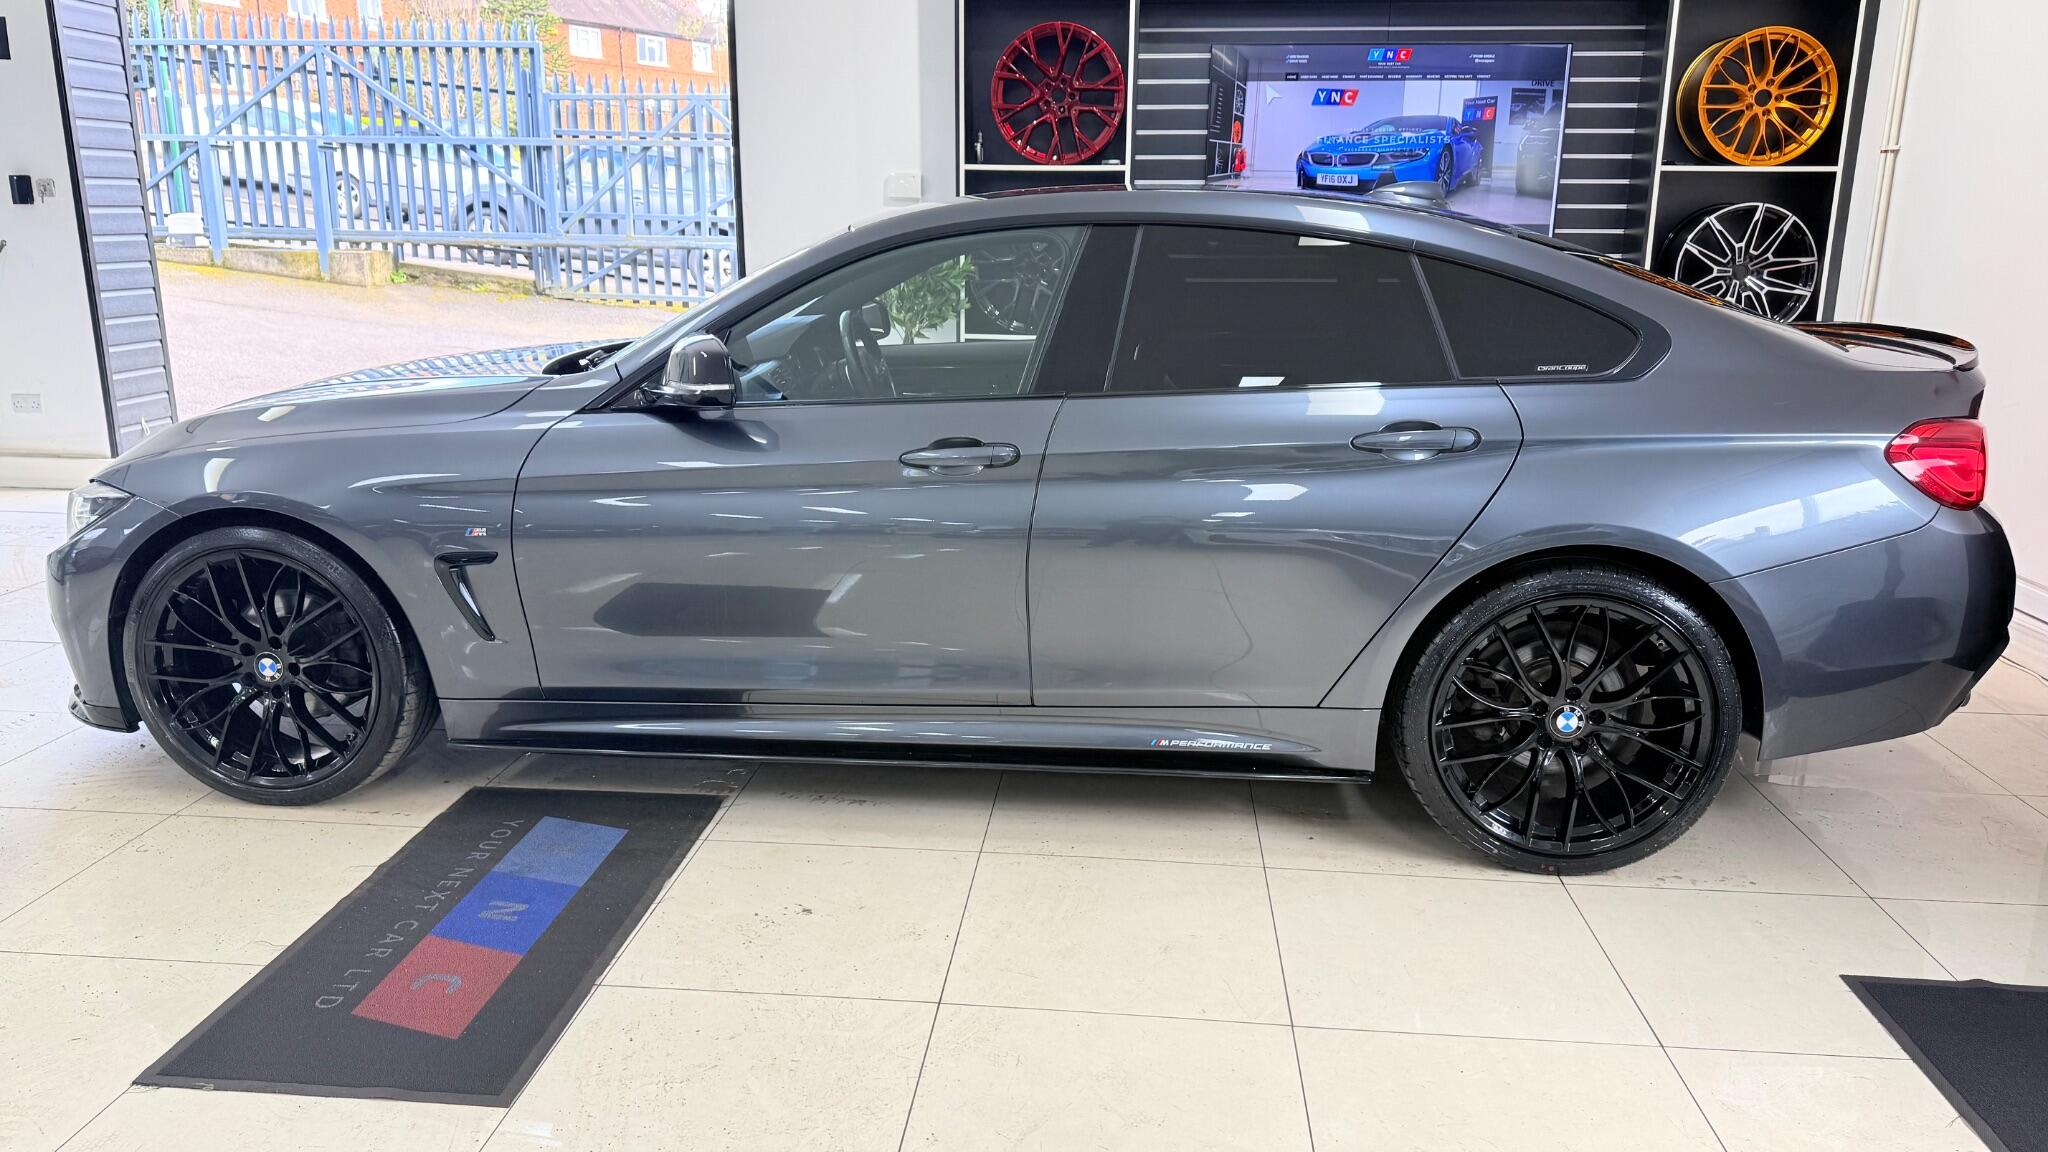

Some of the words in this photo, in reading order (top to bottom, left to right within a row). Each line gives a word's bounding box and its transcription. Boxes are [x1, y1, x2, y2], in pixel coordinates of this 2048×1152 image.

[1373, 50, 1407, 59] YNC
[1531, 79, 1555, 87] DRIVE
[1317, 90, 1354, 103] YNC
[1465, 109, 1493, 119] YNC
[1317, 135, 1369, 144] FINANCE
[1374, 135, 1451, 144] SPECIALISTS
[1170, 738, 1273, 751] PERFORMANCE
[467, 819, 525, 861] YOUR
[415, 867, 468, 913] NEXT
[364, 919, 418, 958] CAR
[314, 968, 372, 1009] LTD
